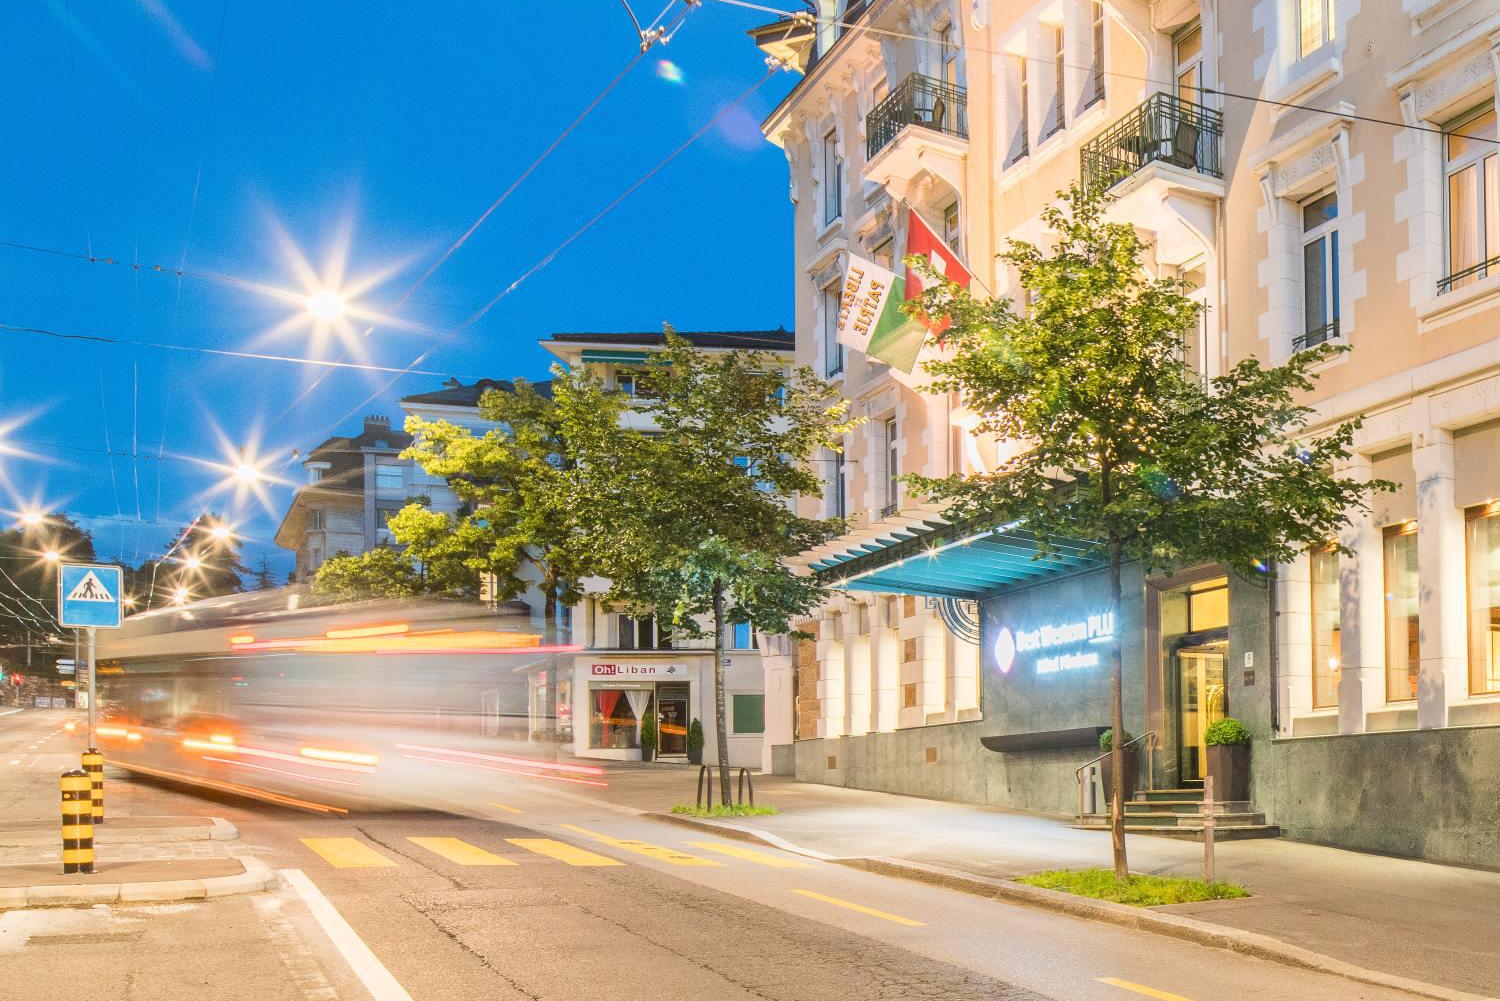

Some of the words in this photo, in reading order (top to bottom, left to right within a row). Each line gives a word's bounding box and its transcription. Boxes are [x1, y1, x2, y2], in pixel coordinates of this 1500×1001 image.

[1087, 611, 1114, 638] PLU
[594, 665, 615, 674] Oh!
[617, 665, 656, 674] Liban
